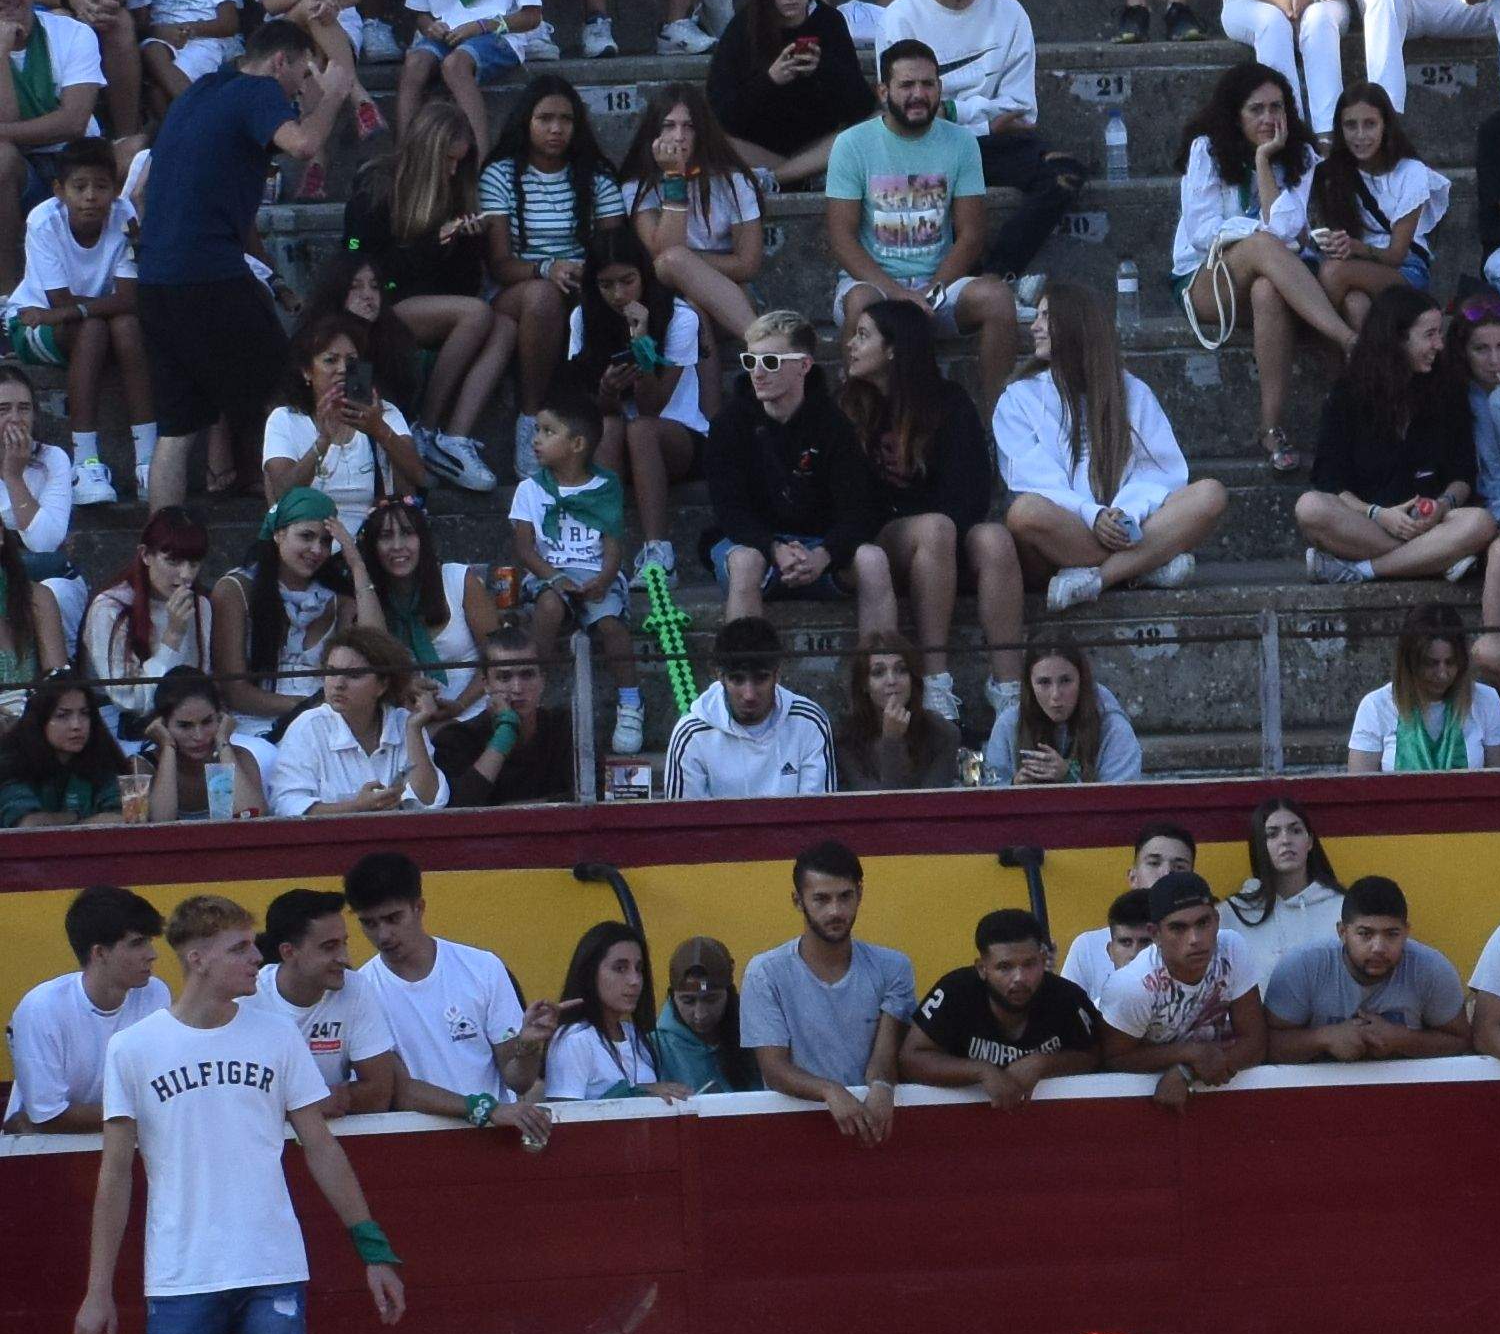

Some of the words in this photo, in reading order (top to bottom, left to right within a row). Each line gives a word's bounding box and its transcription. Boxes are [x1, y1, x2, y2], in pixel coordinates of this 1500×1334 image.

[606, 90, 633, 111] 18
[309, 1021, 342, 1039] 24/7
[150, 1059, 277, 1103] HILFIGER
